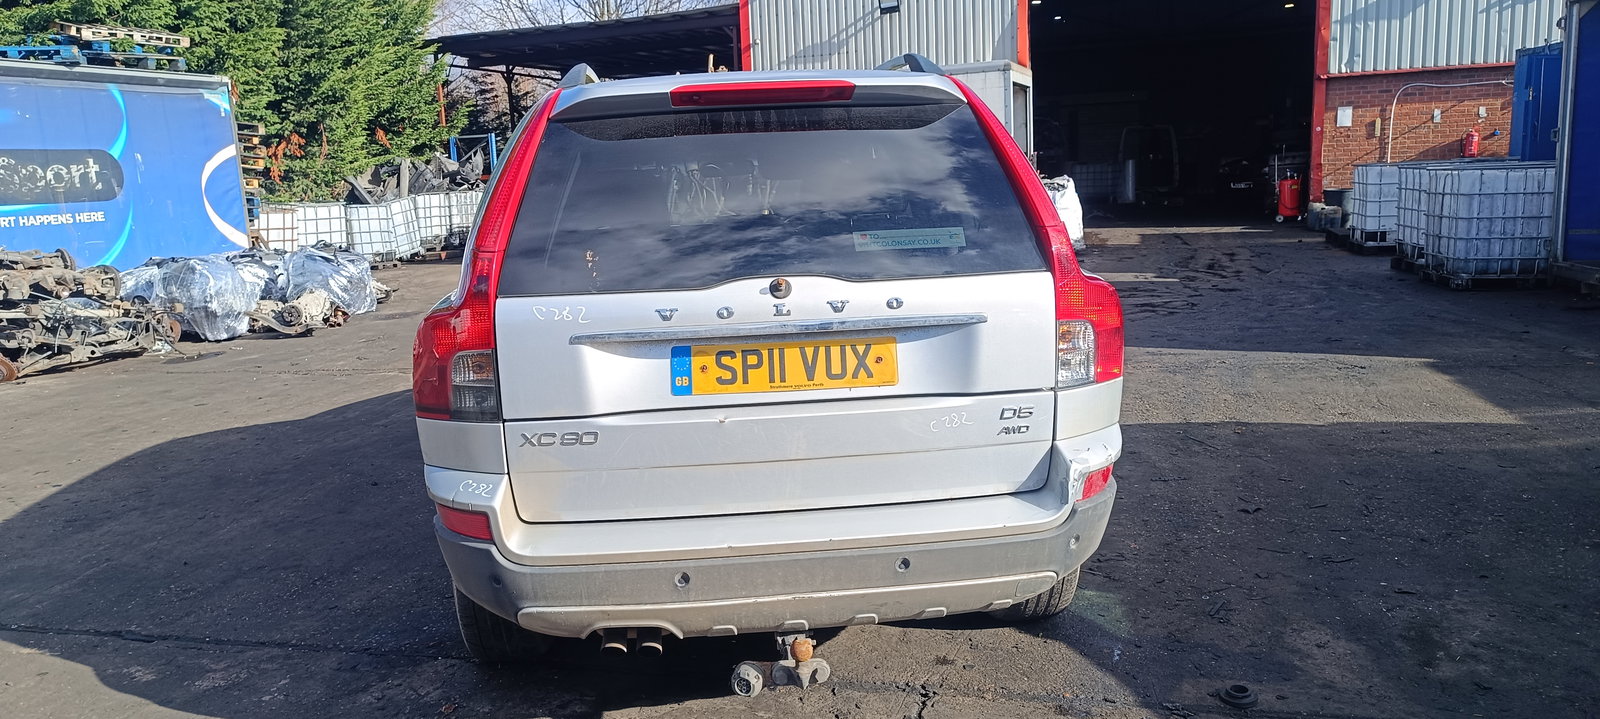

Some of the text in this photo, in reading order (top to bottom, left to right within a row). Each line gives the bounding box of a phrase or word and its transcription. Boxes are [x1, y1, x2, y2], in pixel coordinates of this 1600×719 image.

[0, 211, 105, 228] RT HAPPENS HERE
[654, 297, 903, 321] VOLVO
[798, 343, 874, 382] VUX
[675, 376, 690, 387] GB
[999, 406, 1035, 420] D5
[996, 425, 1030, 436] AWD
